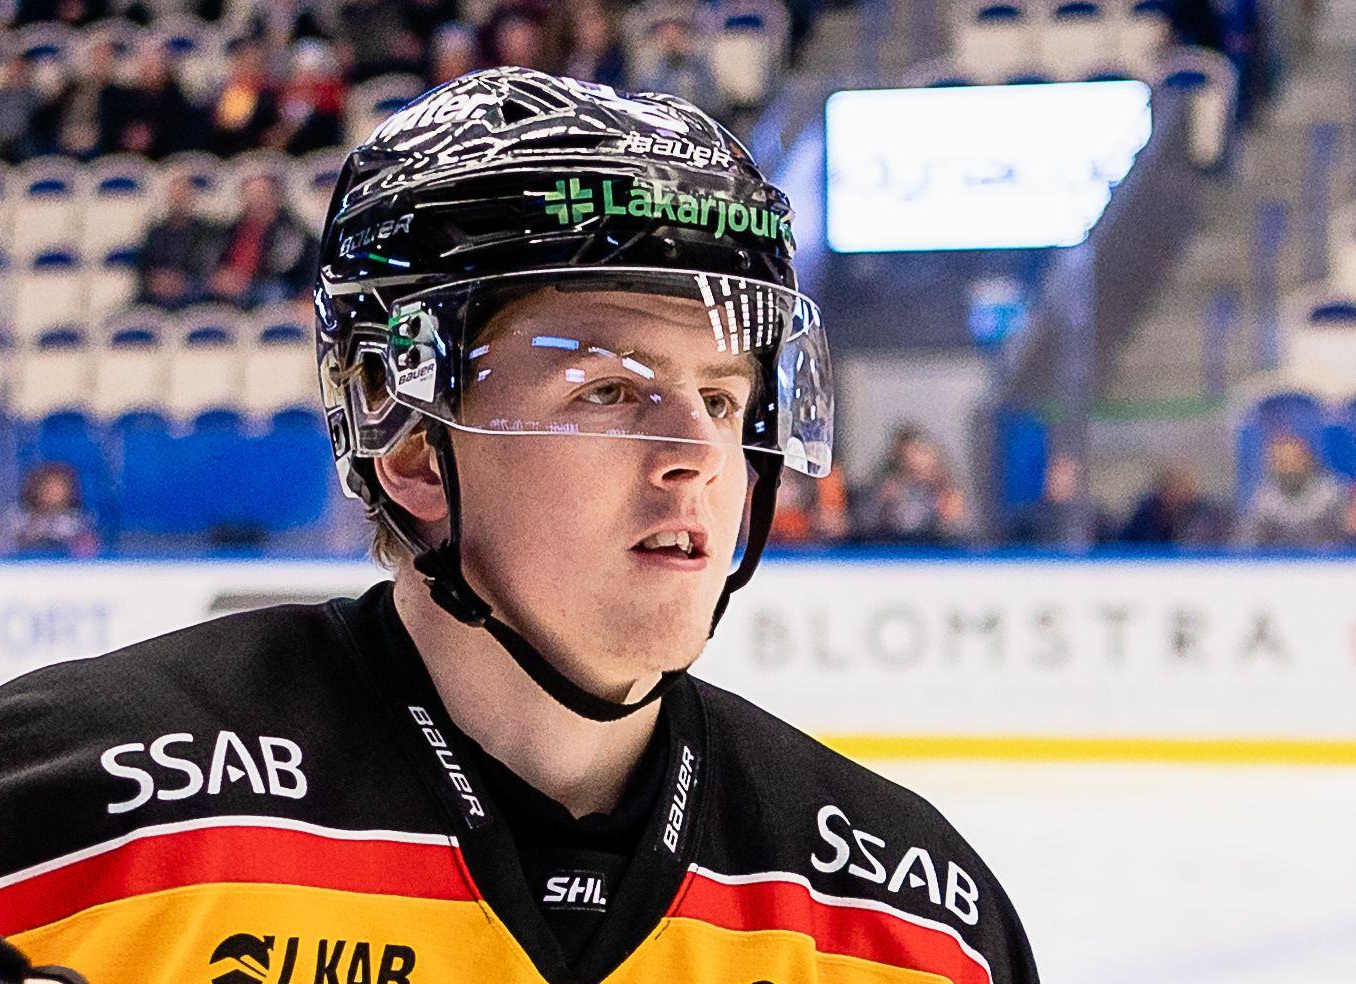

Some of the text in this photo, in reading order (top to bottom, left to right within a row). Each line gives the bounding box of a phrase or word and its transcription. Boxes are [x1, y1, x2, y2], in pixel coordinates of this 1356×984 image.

[748, 602, 1299, 670] BLOMSTRA
[100, 730, 308, 814] SSAB
[543, 876, 606, 905] SHL
[810, 804, 980, 926] SSAB
